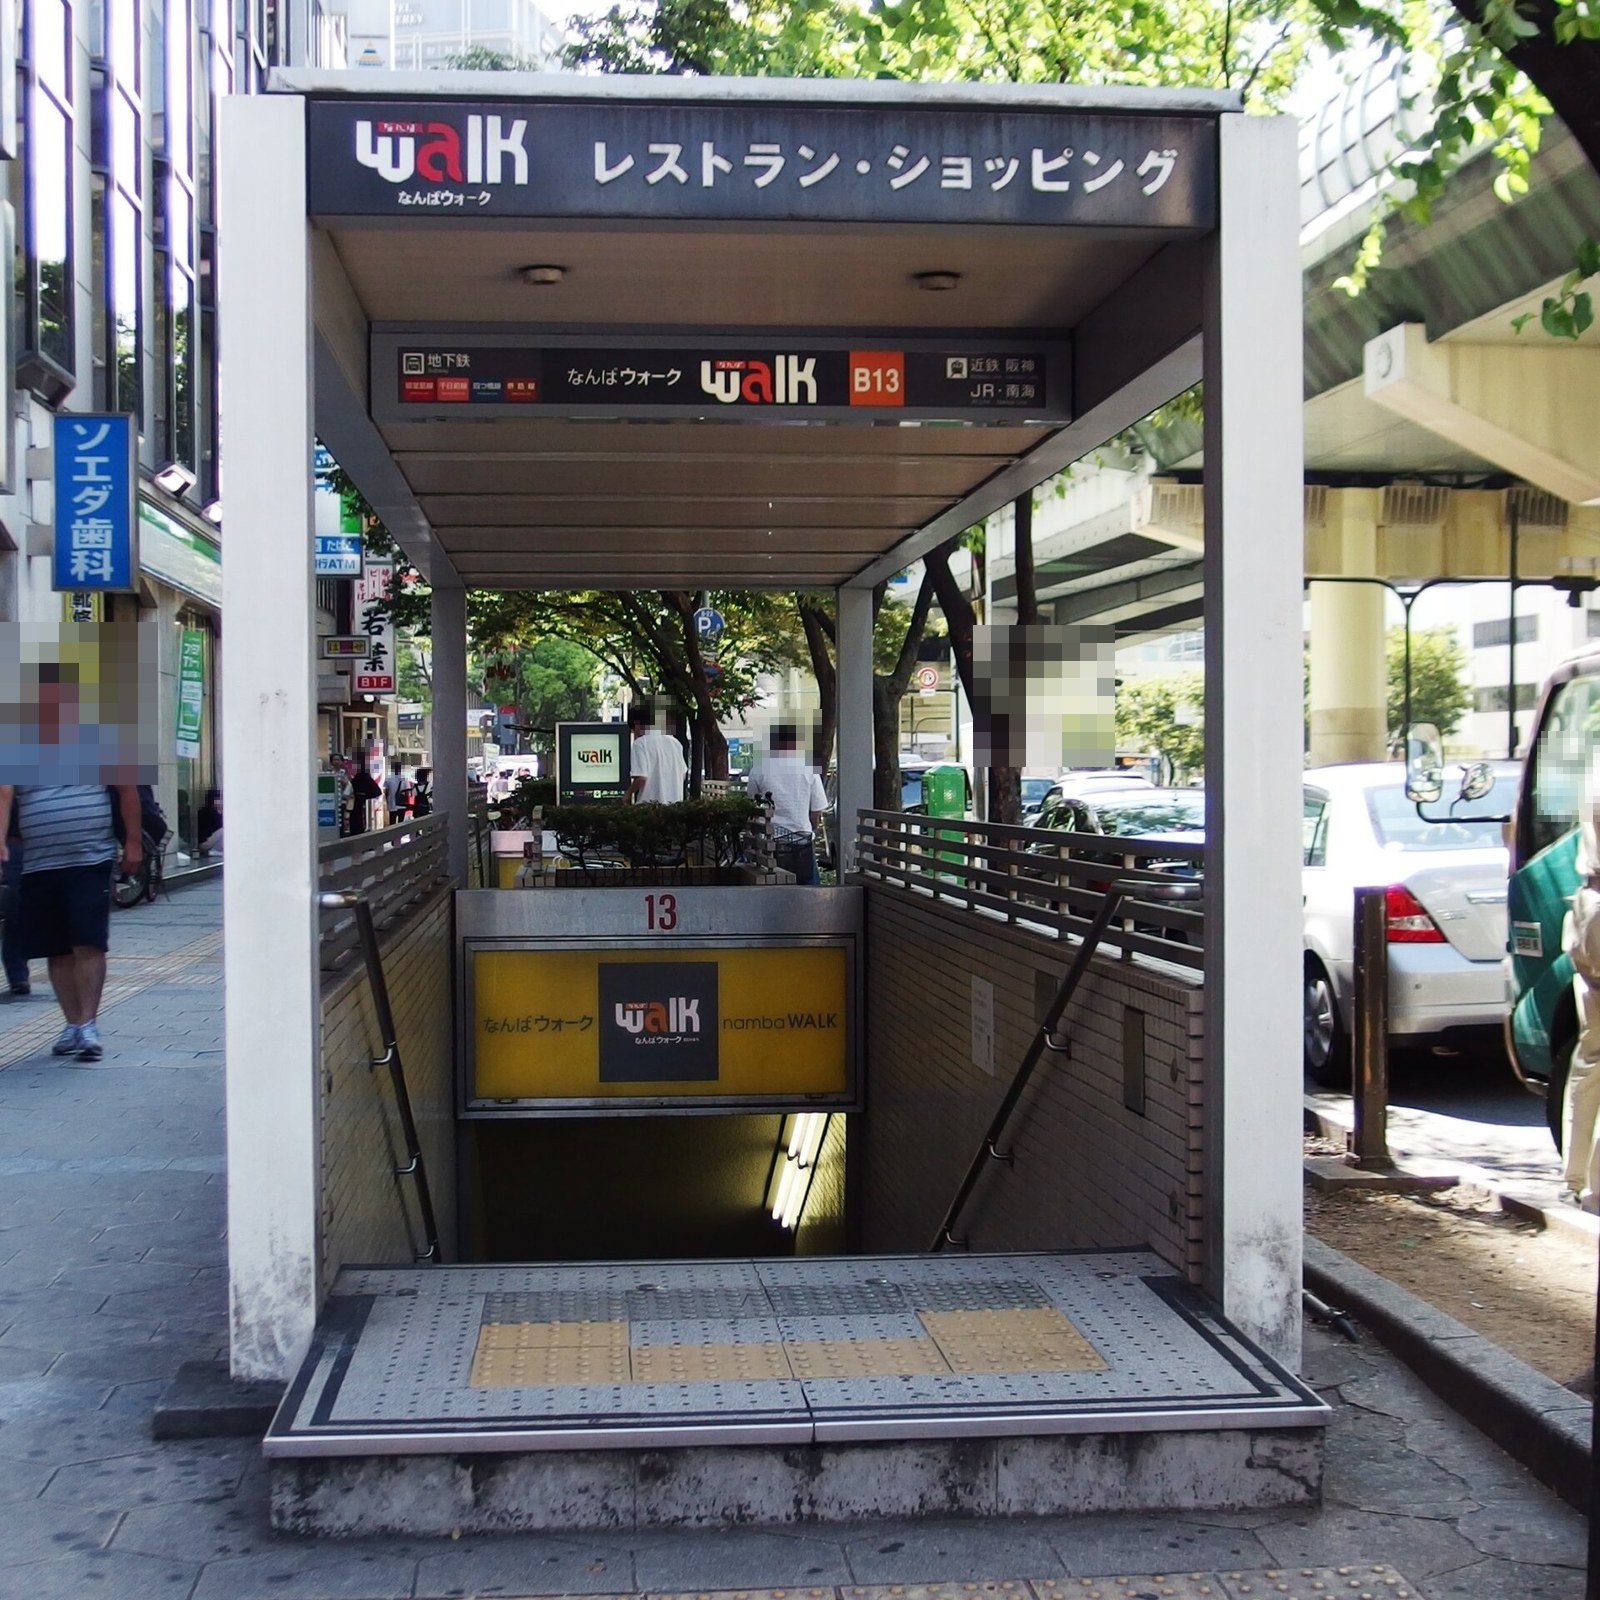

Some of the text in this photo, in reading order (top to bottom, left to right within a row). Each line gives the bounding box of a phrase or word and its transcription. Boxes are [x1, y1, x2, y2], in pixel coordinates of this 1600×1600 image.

[593, 141, 1179, 196] レストラン・ショッピング
[397, 190, 492, 206] なんばウォーク
[427, 353, 471, 368] 地下鉄
[970, 358, 1035, 373] 近鉄 阪神
[567, 367, 682, 386] なんばウォーク
[853, 367, 900, 393] B13
[70, 423, 114, 582] ソエダ歯科
[361, 676, 389, 687] B1F
[644, 894, 677, 930] 13
[483, 1014, 594, 1034] なんばウォーク
